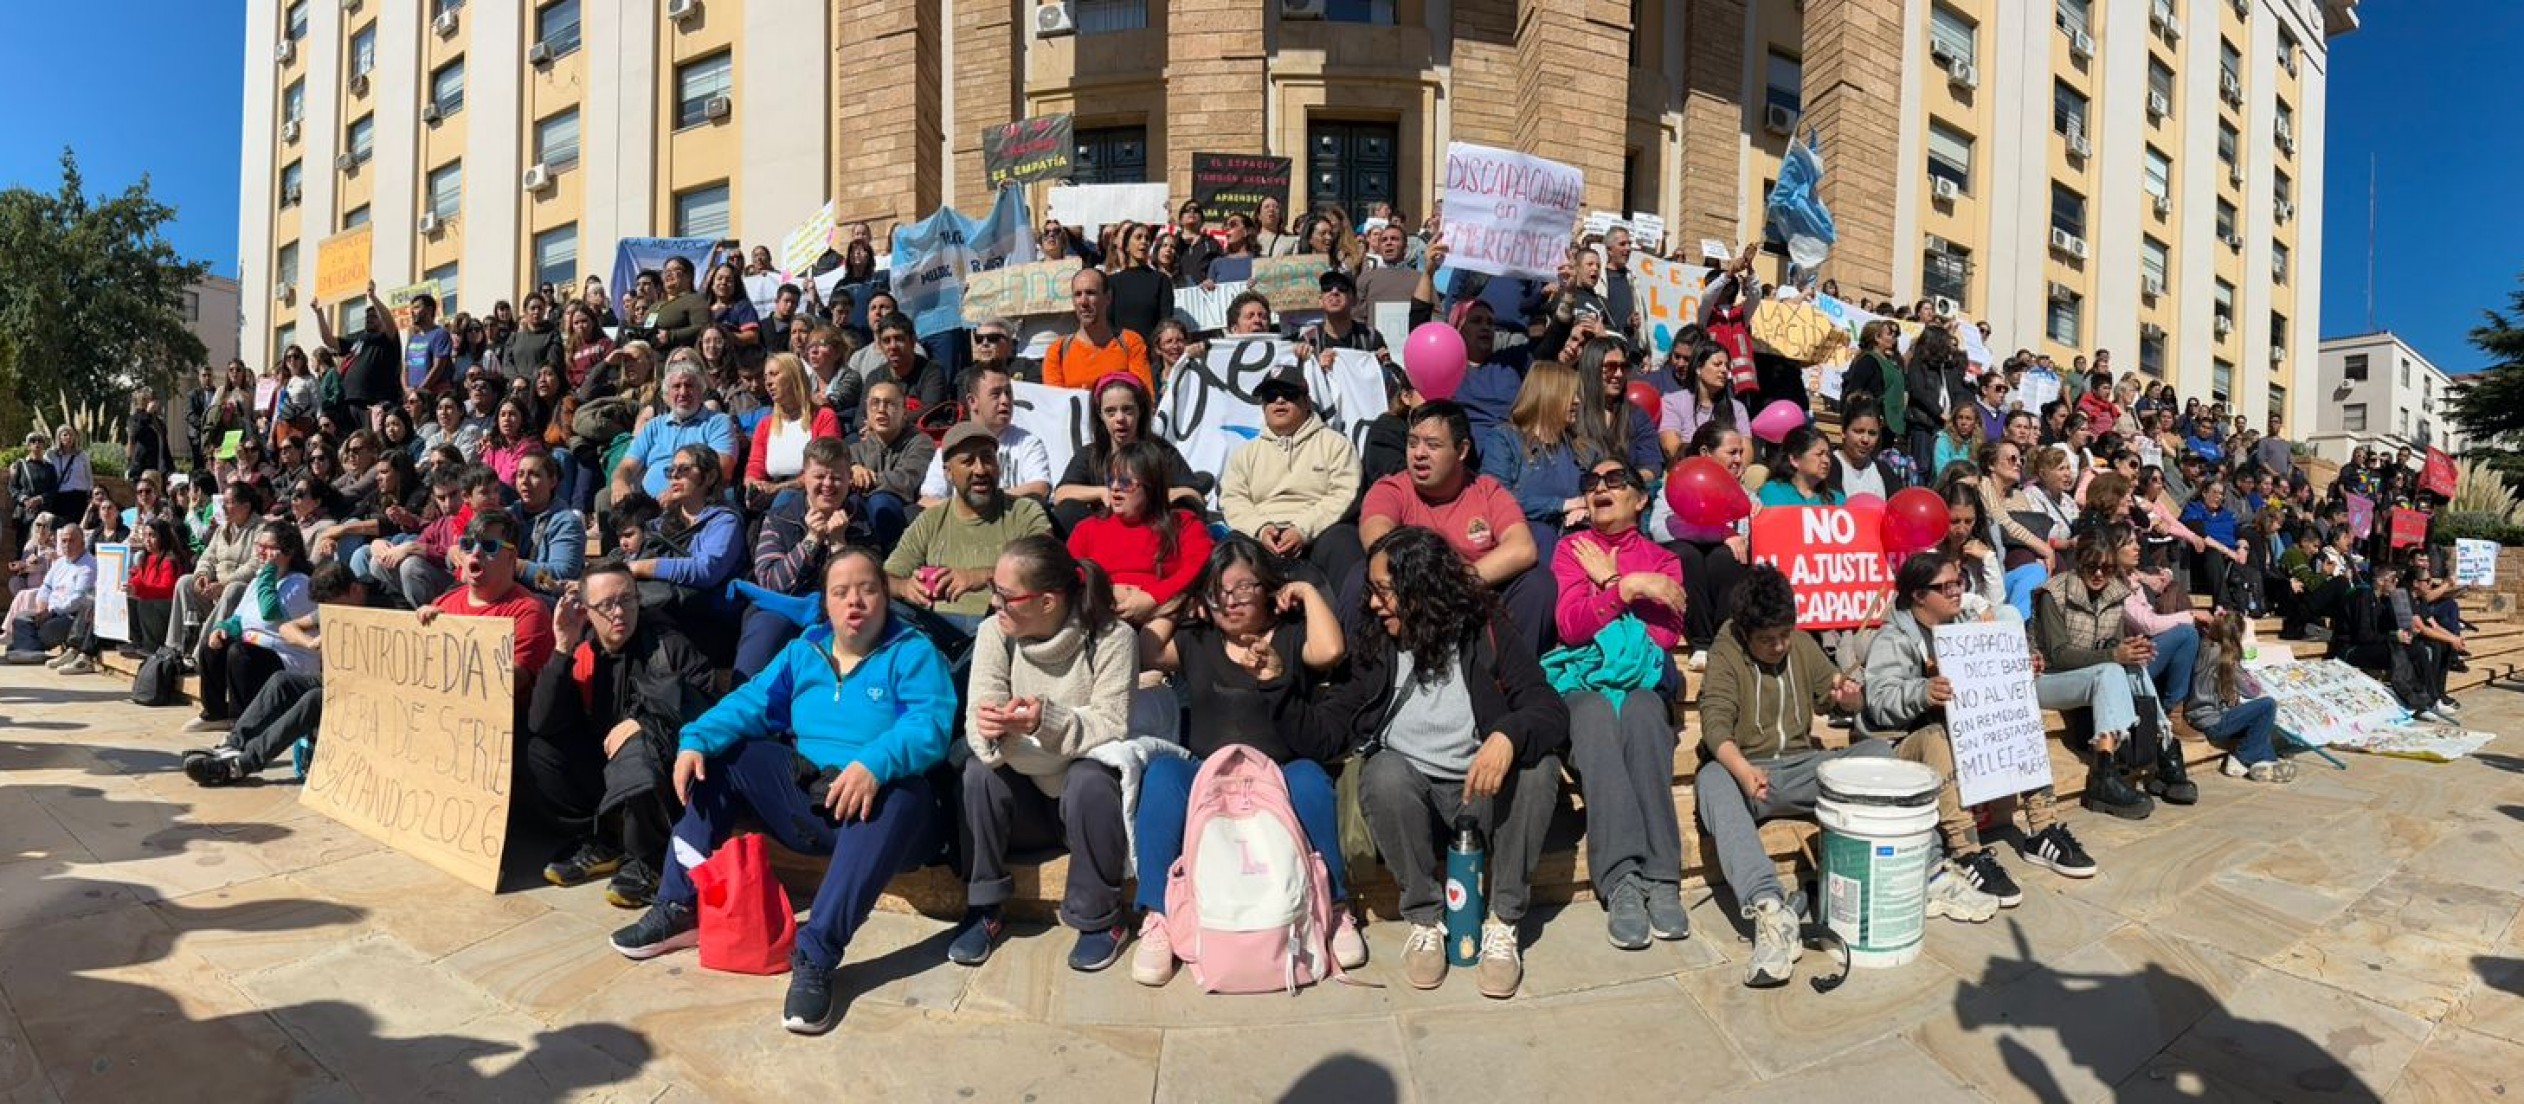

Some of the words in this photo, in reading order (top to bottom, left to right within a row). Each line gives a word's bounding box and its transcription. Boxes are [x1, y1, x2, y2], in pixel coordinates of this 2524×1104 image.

[1447, 153, 1579, 210] DISCAPACIDAD
[1494, 201, 1517, 219] en
[1802, 506, 1855, 545] NO
[1790, 552, 1883, 585] AJUSTE
[326, 617, 409, 686] CENTRO
[442, 626, 487, 700] DÍA
[1964, 660, 1997, 679] DICE
[1953, 688, 1979, 711] NO
[1983, 684, 2003, 704] AL
[1952, 718, 1975, 738] SIN
[1976, 706, 2030, 729] REMEDIOS
[434, 706, 513, 796] SERIE
[1957, 738, 1979, 754] SIN
[421, 790, 503, 859] 2026
